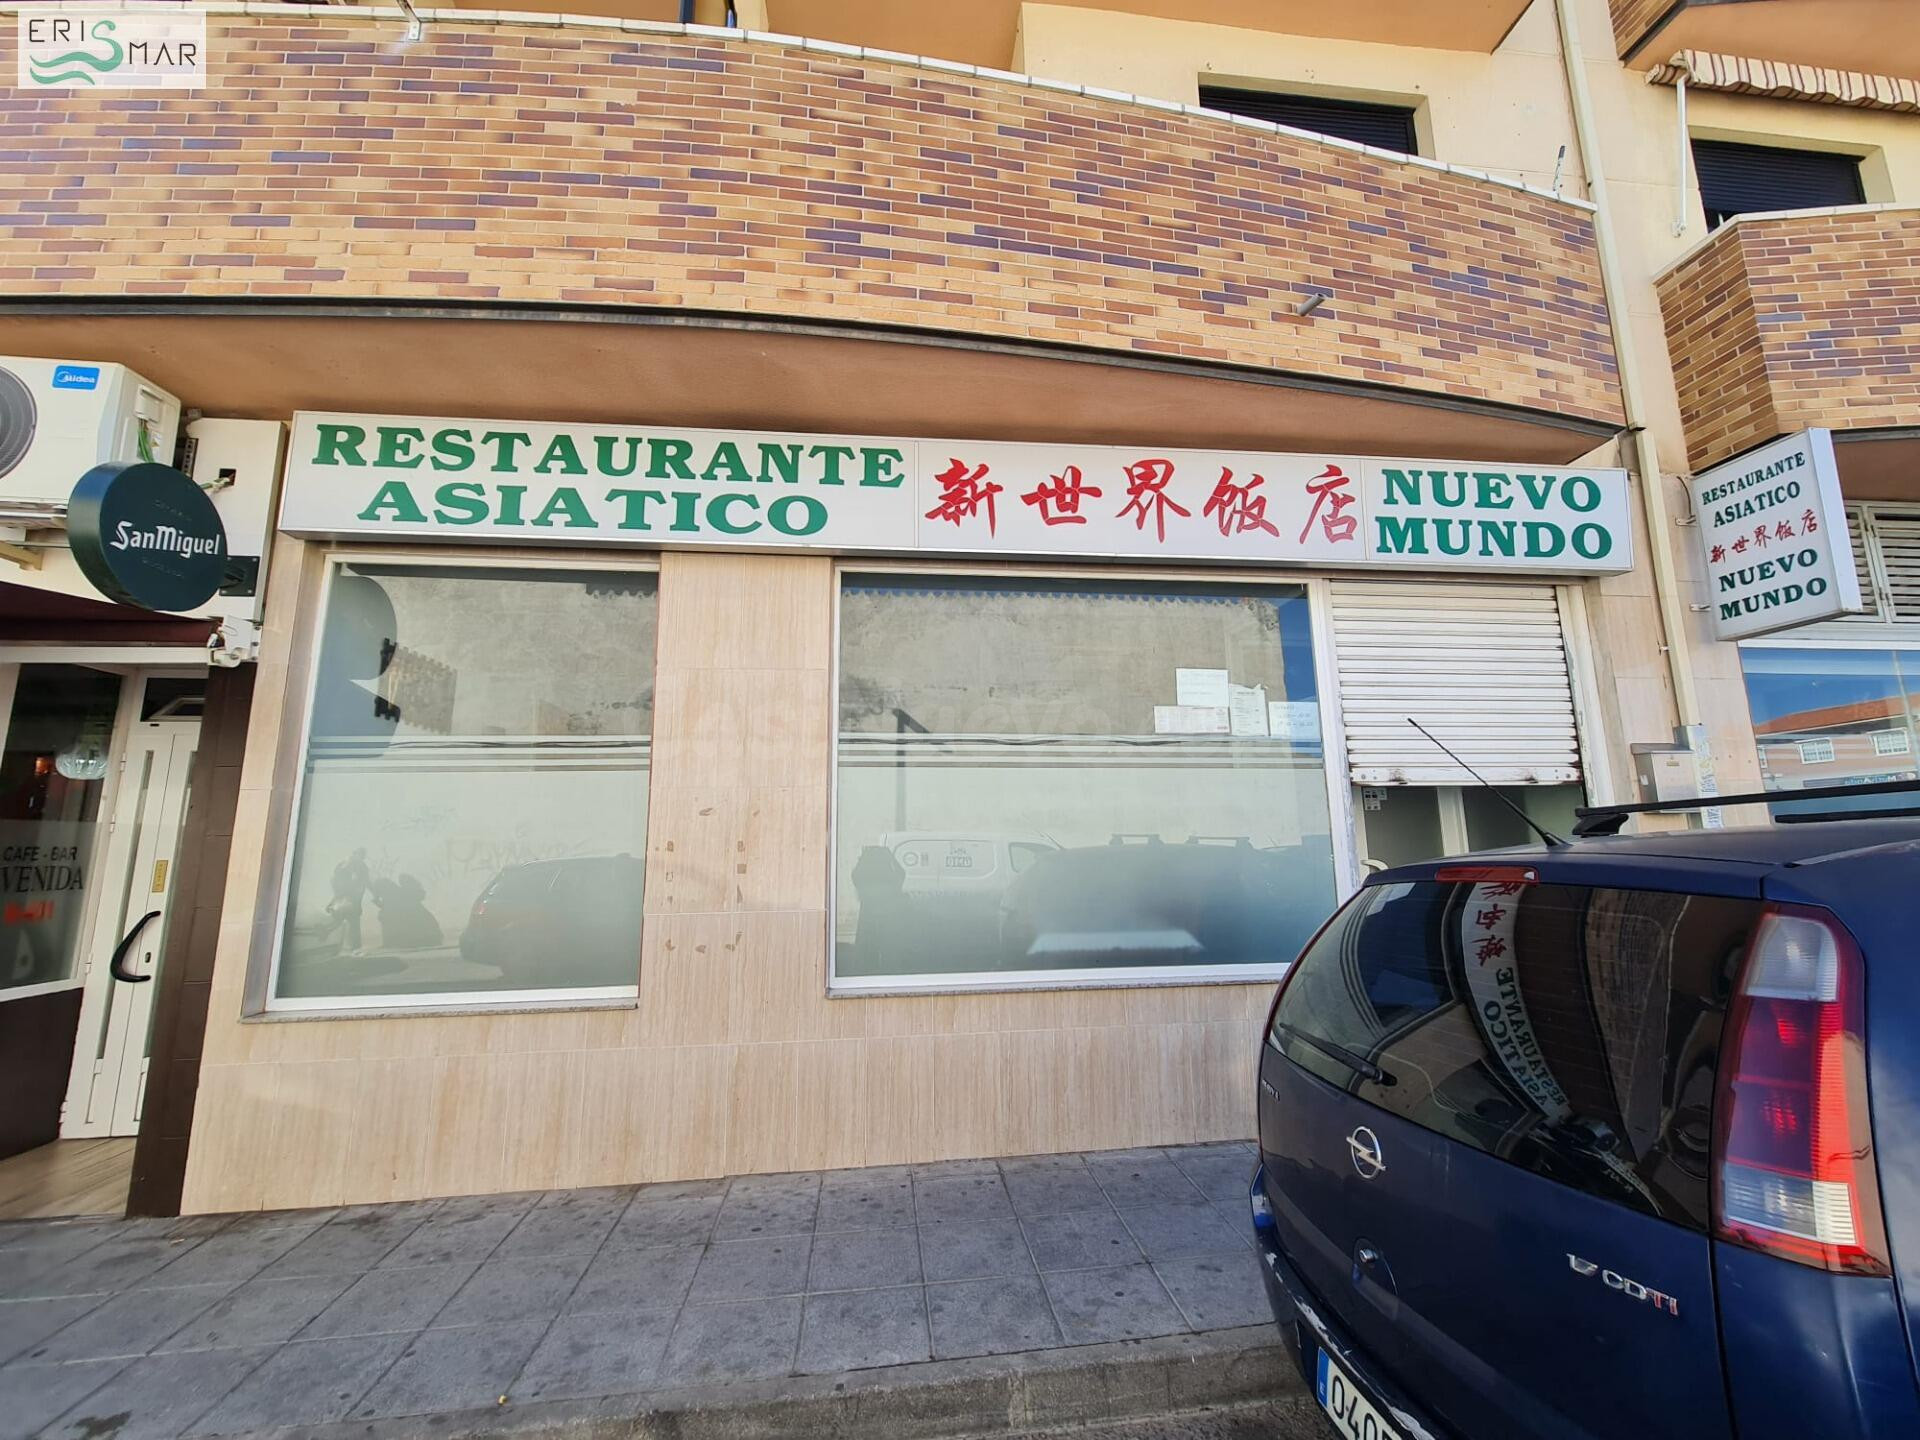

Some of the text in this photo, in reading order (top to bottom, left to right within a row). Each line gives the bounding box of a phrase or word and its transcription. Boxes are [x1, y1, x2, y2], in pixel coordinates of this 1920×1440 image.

[55, 371, 96, 383] Midea
[311, 423, 905, 488] RESTAURANTE
[1702, 451, 1806, 506] RESTAURANTE
[356, 480, 829, 537] ASIATICO
[925, 457, 1358, 545] 新世界饭店
[1381, 467, 1603, 513] NUEVO
[1713, 480, 1801, 528] ASIATICO
[1374, 514, 1613, 560] MUNDO
[1710, 508, 1819, 564] 新世界饭店
[1718, 548, 1819, 593] NUEVO
[1719, 577, 1828, 621] MUNDO
[50, 845, 78, 861] BAR
[1332, 1375, 1393, 1440] 040
